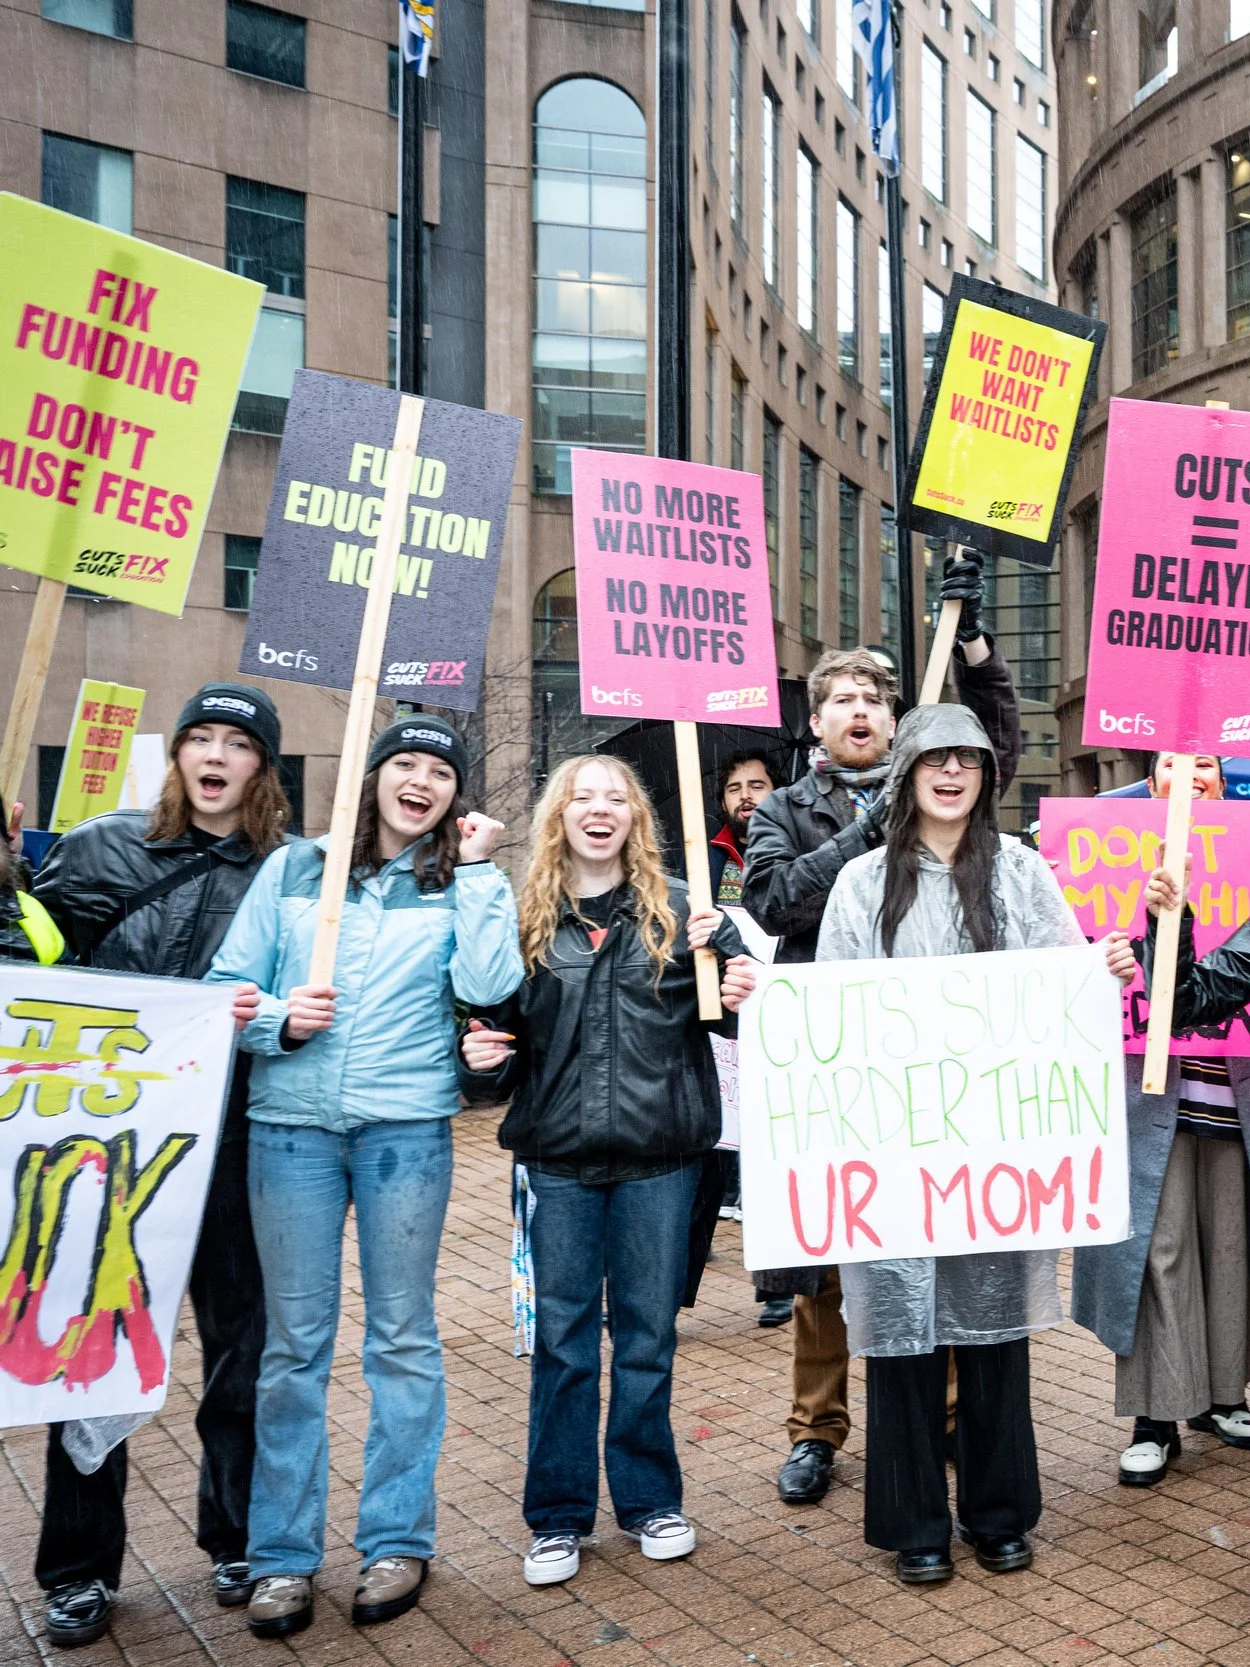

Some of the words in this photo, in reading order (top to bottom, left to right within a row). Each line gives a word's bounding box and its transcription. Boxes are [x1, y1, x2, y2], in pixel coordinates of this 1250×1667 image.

[86, 268, 159, 333] FIX
[15, 303, 199, 405] FUNDING
[968, 331, 1004, 367] WE
[1008, 344, 1072, 388] DON'T
[981, 369, 1045, 413] WANT
[26, 392, 156, 471] DON'T
[949, 392, 1060, 452] WAITLISTS
[348, 442, 448, 499] FUD
[93, 471, 194, 540] FEES
[283, 479, 491, 560] EDUCTION
[602, 478, 642, 515] NO
[655, 484, 741, 530] MORE
[74, 562, 120, 578] SUCK
[79, 549, 125, 565] CUTS
[593, 517, 751, 570] WAITLISTS
[606, 578, 647, 616] NO
[659, 583, 748, 626] MORE
[258, 642, 319, 671] bcfs
[386, 662, 430, 674] CUTS
[614, 619, 744, 666] LAYOFFS
[591, 685, 644, 707] bcfs
[1099, 709, 1157, 737] bcfs
[1062, 879, 1142, 929] MY
[758, 977, 919, 1068] CUTS
[941, 963, 1102, 1057] SUCK
[763, 1058, 969, 1161] HARDER
[979, 1057, 1111, 1142] THAN
[788, 1160, 884, 1258] UR
[919, 1144, 1103, 1244] MOM!
